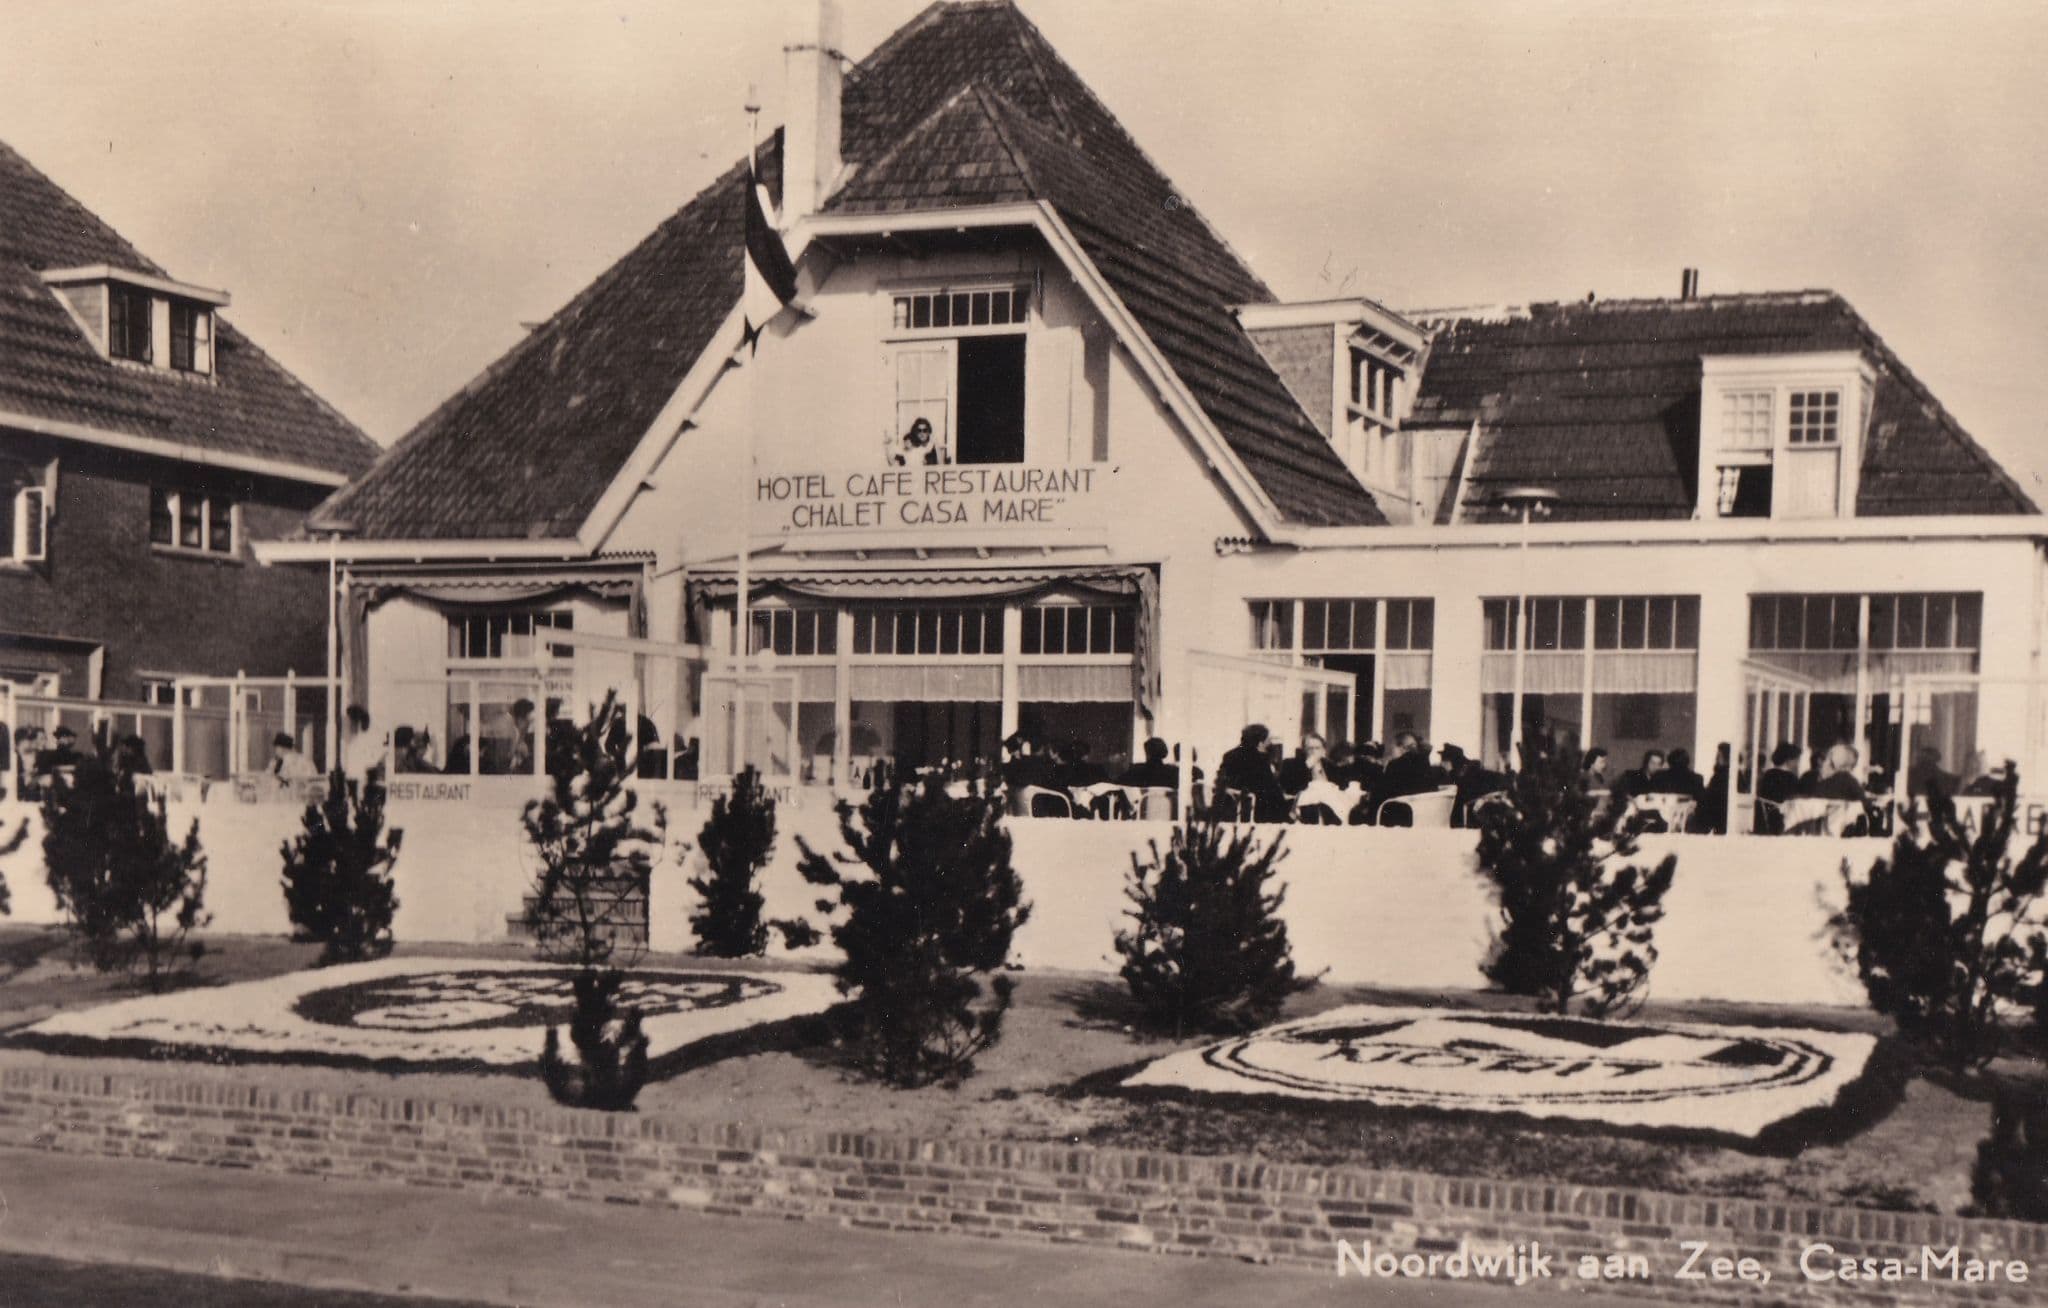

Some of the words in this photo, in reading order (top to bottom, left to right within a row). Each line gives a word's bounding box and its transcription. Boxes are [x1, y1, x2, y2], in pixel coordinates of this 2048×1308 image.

[757, 475, 835, 501] HOTEL
[924, 468, 1097, 495] RESTAURANT
[899, 500, 968, 525] CASA
[389, 783, 472, 801] RESTAURANT
